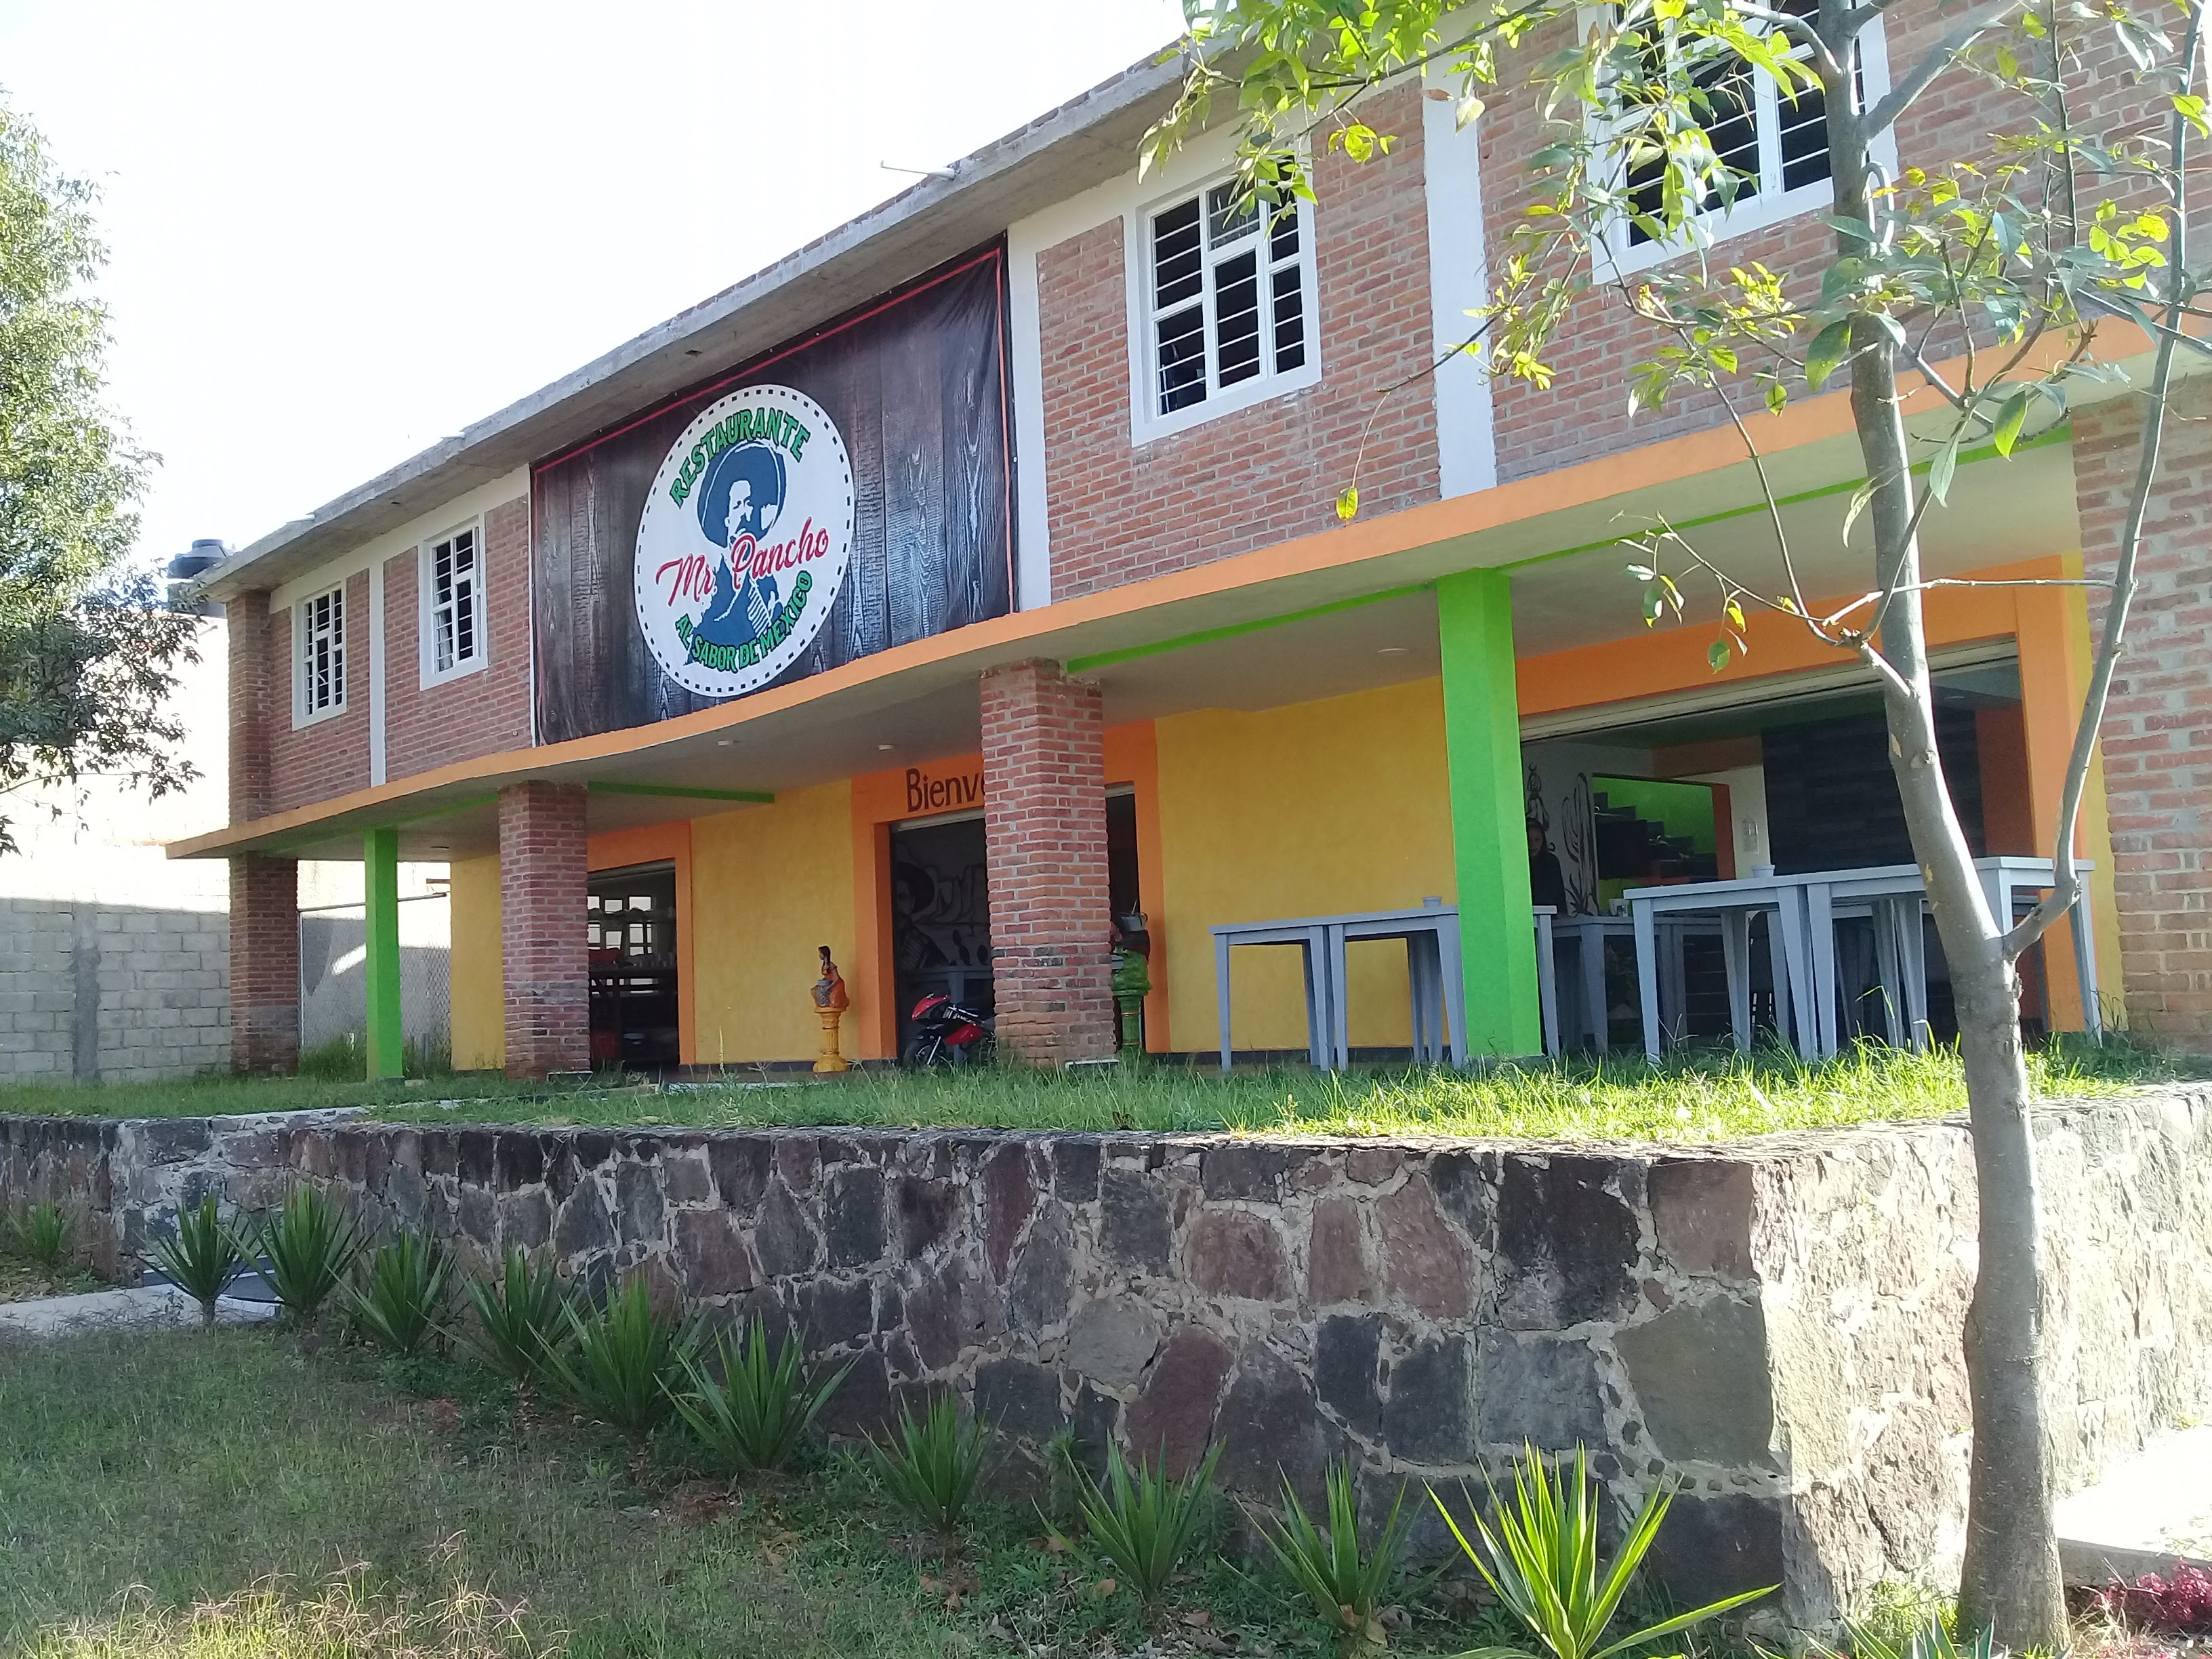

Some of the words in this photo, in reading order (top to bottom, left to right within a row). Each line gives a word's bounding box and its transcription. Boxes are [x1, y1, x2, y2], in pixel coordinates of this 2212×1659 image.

[669, 407, 812, 510] RESTAURANTE
[730, 516, 829, 590] Pancho
[675, 613, 694, 651] AL
[689, 634, 739, 674] SABOR
[738, 638, 760, 670] DE
[758, 570, 813, 659] MEXICO
[905, 768, 985, 813] Bienv
